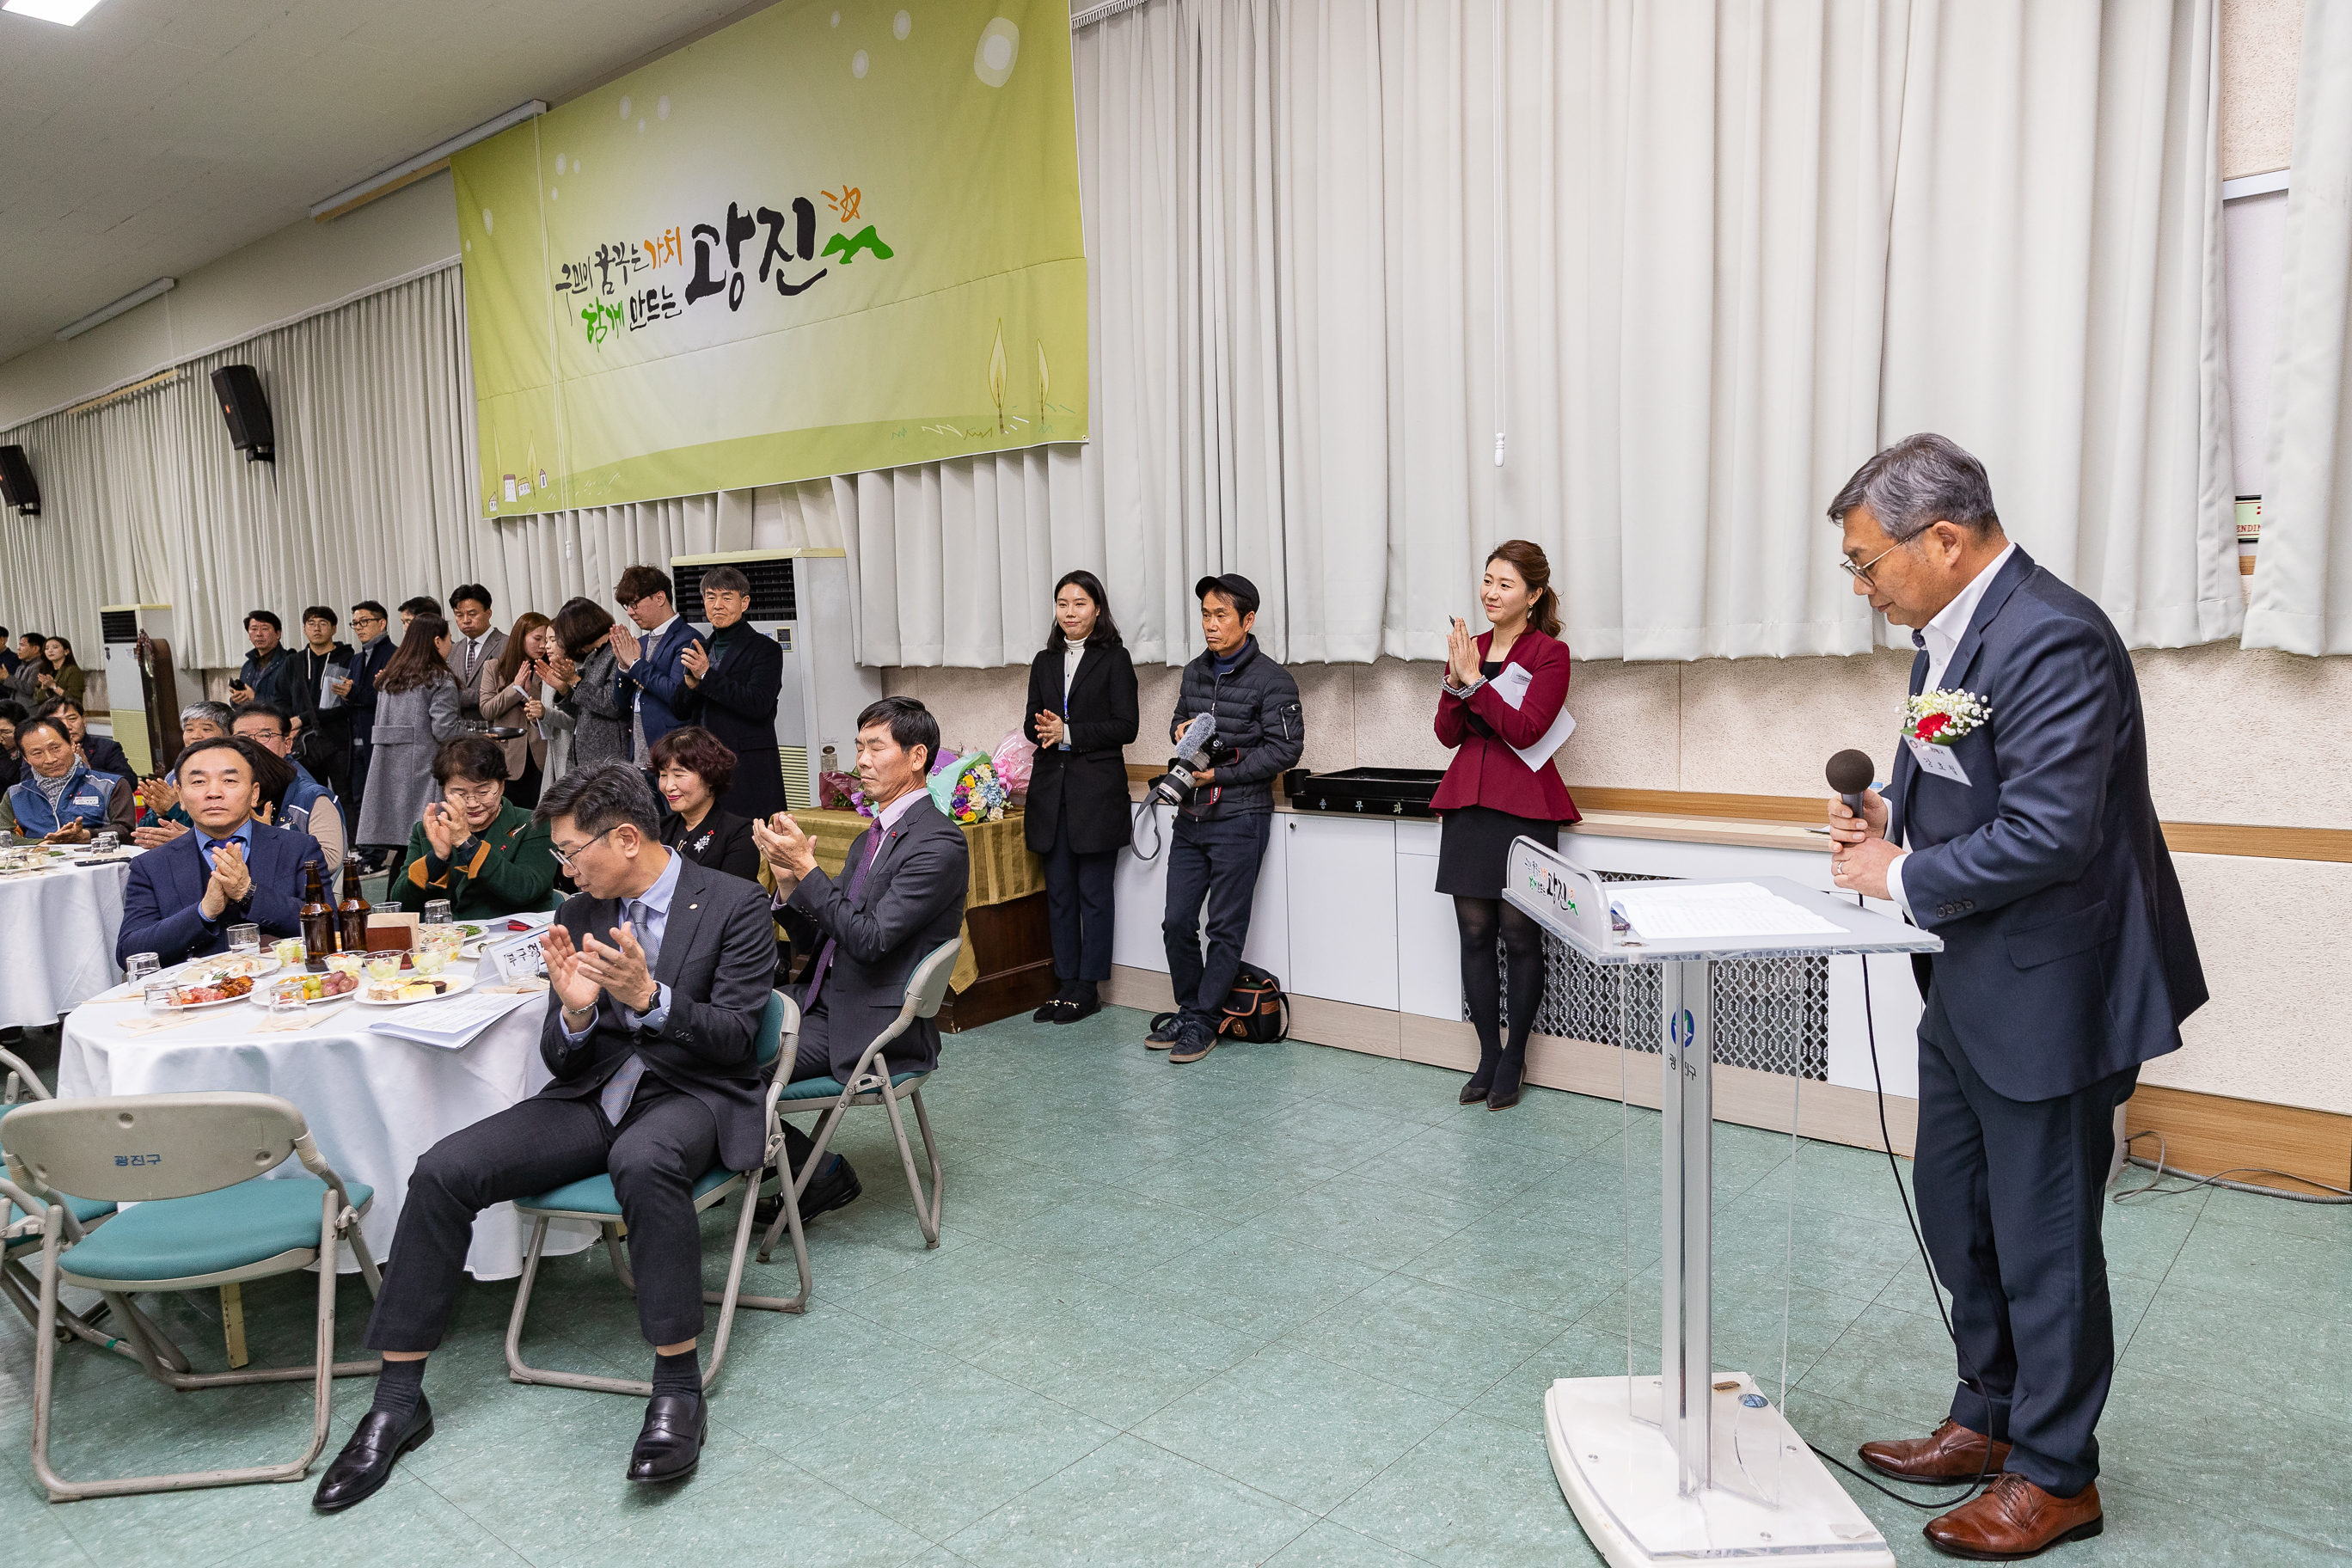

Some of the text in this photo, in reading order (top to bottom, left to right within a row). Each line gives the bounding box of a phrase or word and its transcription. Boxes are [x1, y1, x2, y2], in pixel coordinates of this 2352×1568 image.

[555, 226, 683, 326] 구민이 꿈꾸는 가치
[685, 197, 828, 312] 광진
[581, 285, 683, 353] 함께 만드는
[113, 1154, 162, 1167] 광진구
